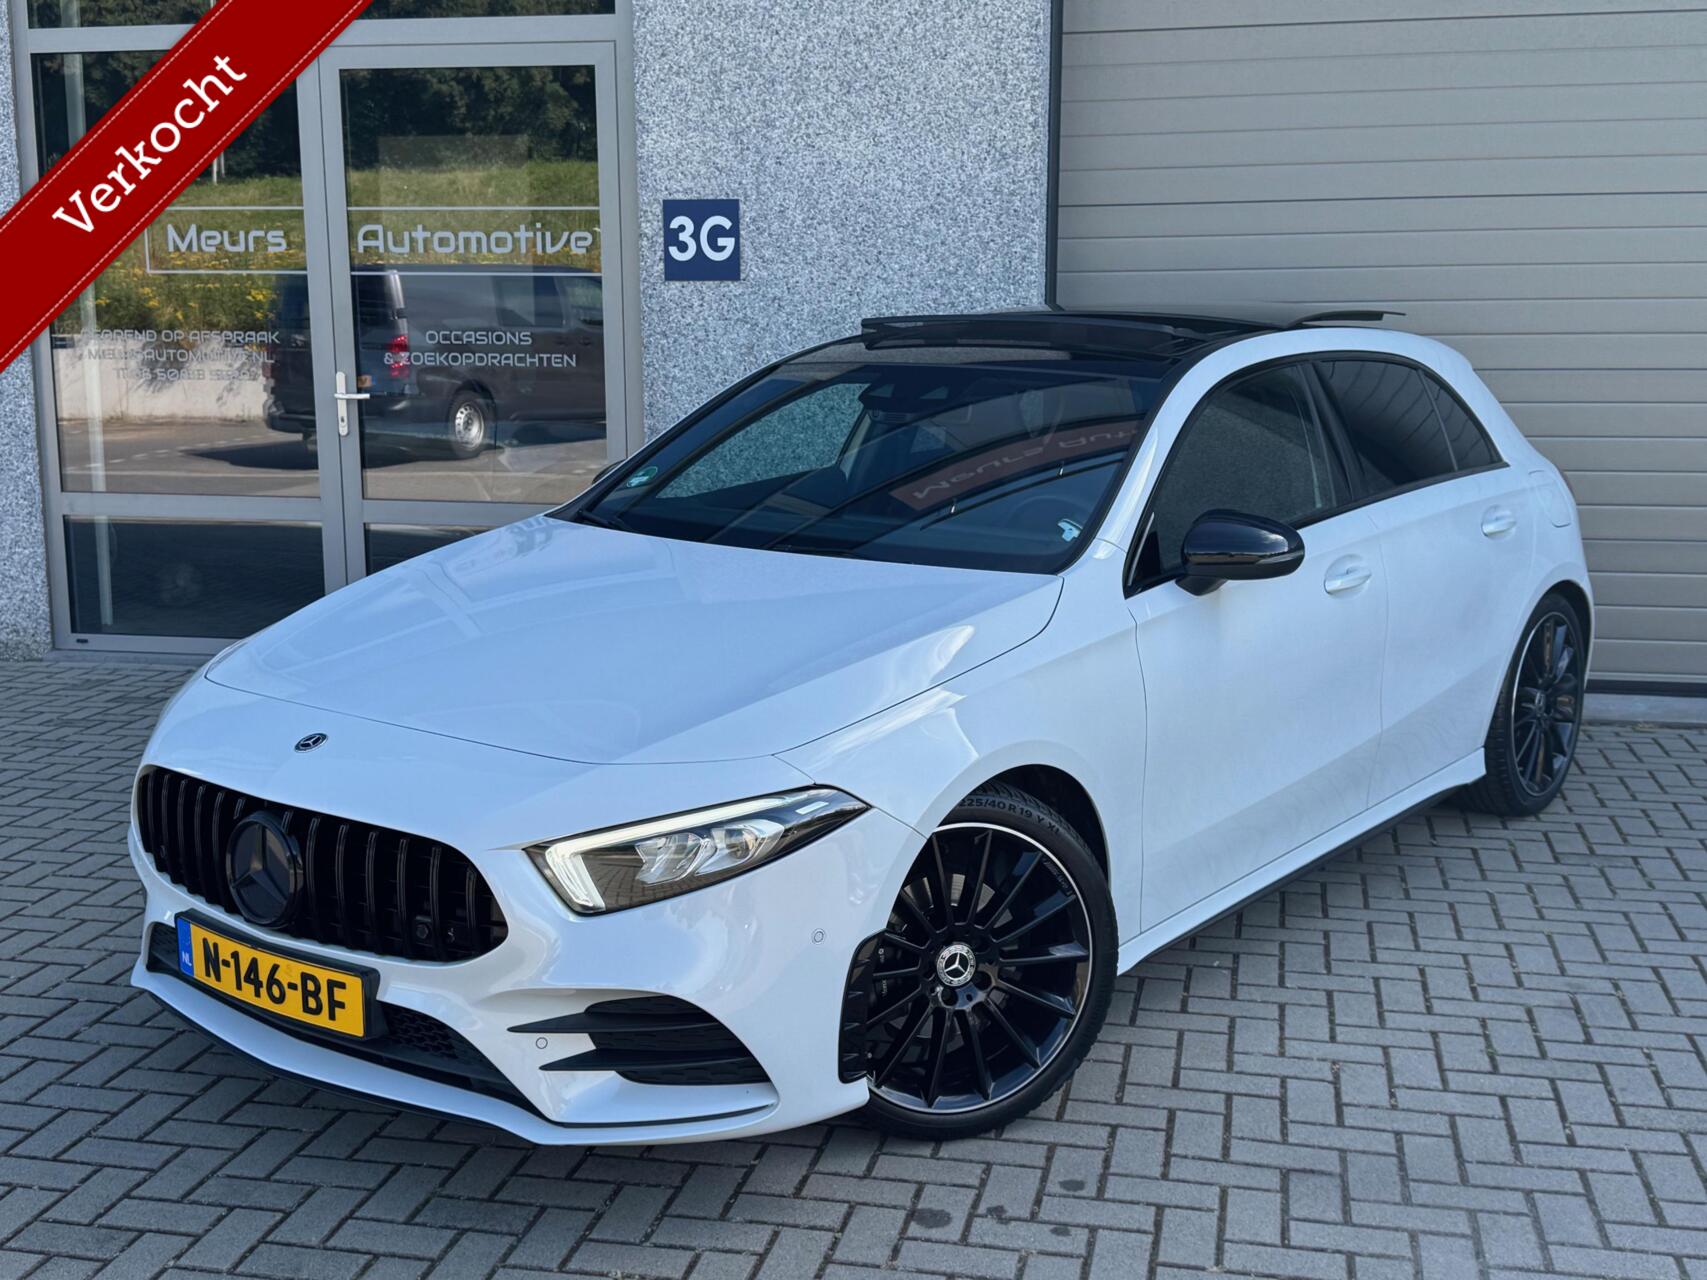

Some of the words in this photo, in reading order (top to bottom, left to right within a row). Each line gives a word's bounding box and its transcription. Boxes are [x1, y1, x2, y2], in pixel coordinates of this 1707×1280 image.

[167, 224, 287, 252] Meurs
[357, 223, 593, 254] Automotive
[668, 215, 736, 262] 3G
[161, 330, 184, 342] OP
[189, 330, 281, 344] AFSPRAAK
[425, 330, 533, 345] OCCASIONS
[383, 352, 394, 365] &
[399, 352, 577, 368] ZOEKOPDRACHTEN
[181, 951, 192, 967] NL
[202, 937, 346, 1021] N-146-BF
